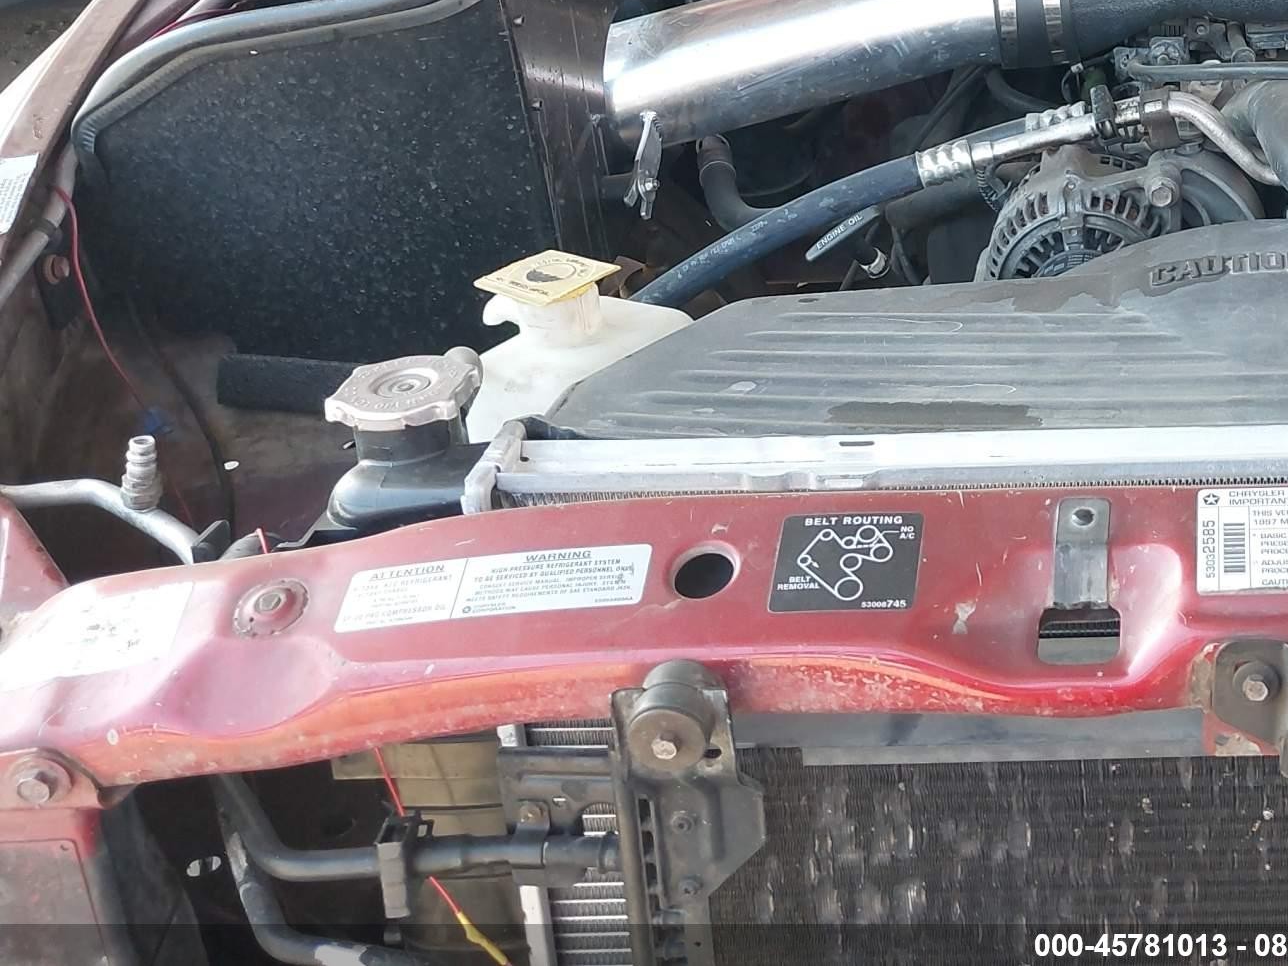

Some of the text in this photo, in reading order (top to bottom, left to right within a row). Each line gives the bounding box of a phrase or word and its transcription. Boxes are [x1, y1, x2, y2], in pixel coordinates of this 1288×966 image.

[816, 213, 863, 250] ENGINE OIL
[1229, 489, 1285, 498] CHRYSLER
[805, 515, 903, 526] BELT ROUTING
[899, 532, 916, 540] A/C
[525, 550, 592, 562] WARNING
[510, 564, 544, 572] PRESSURE
[546, 560, 592, 569] REFRIGERANT
[594, 558, 620, 566] SYSTEM
[576, 566, 614, 574] PERSONNEL
[370, 564, 445, 579] ATTENTION
[777, 583, 820, 591] REMOVAL
